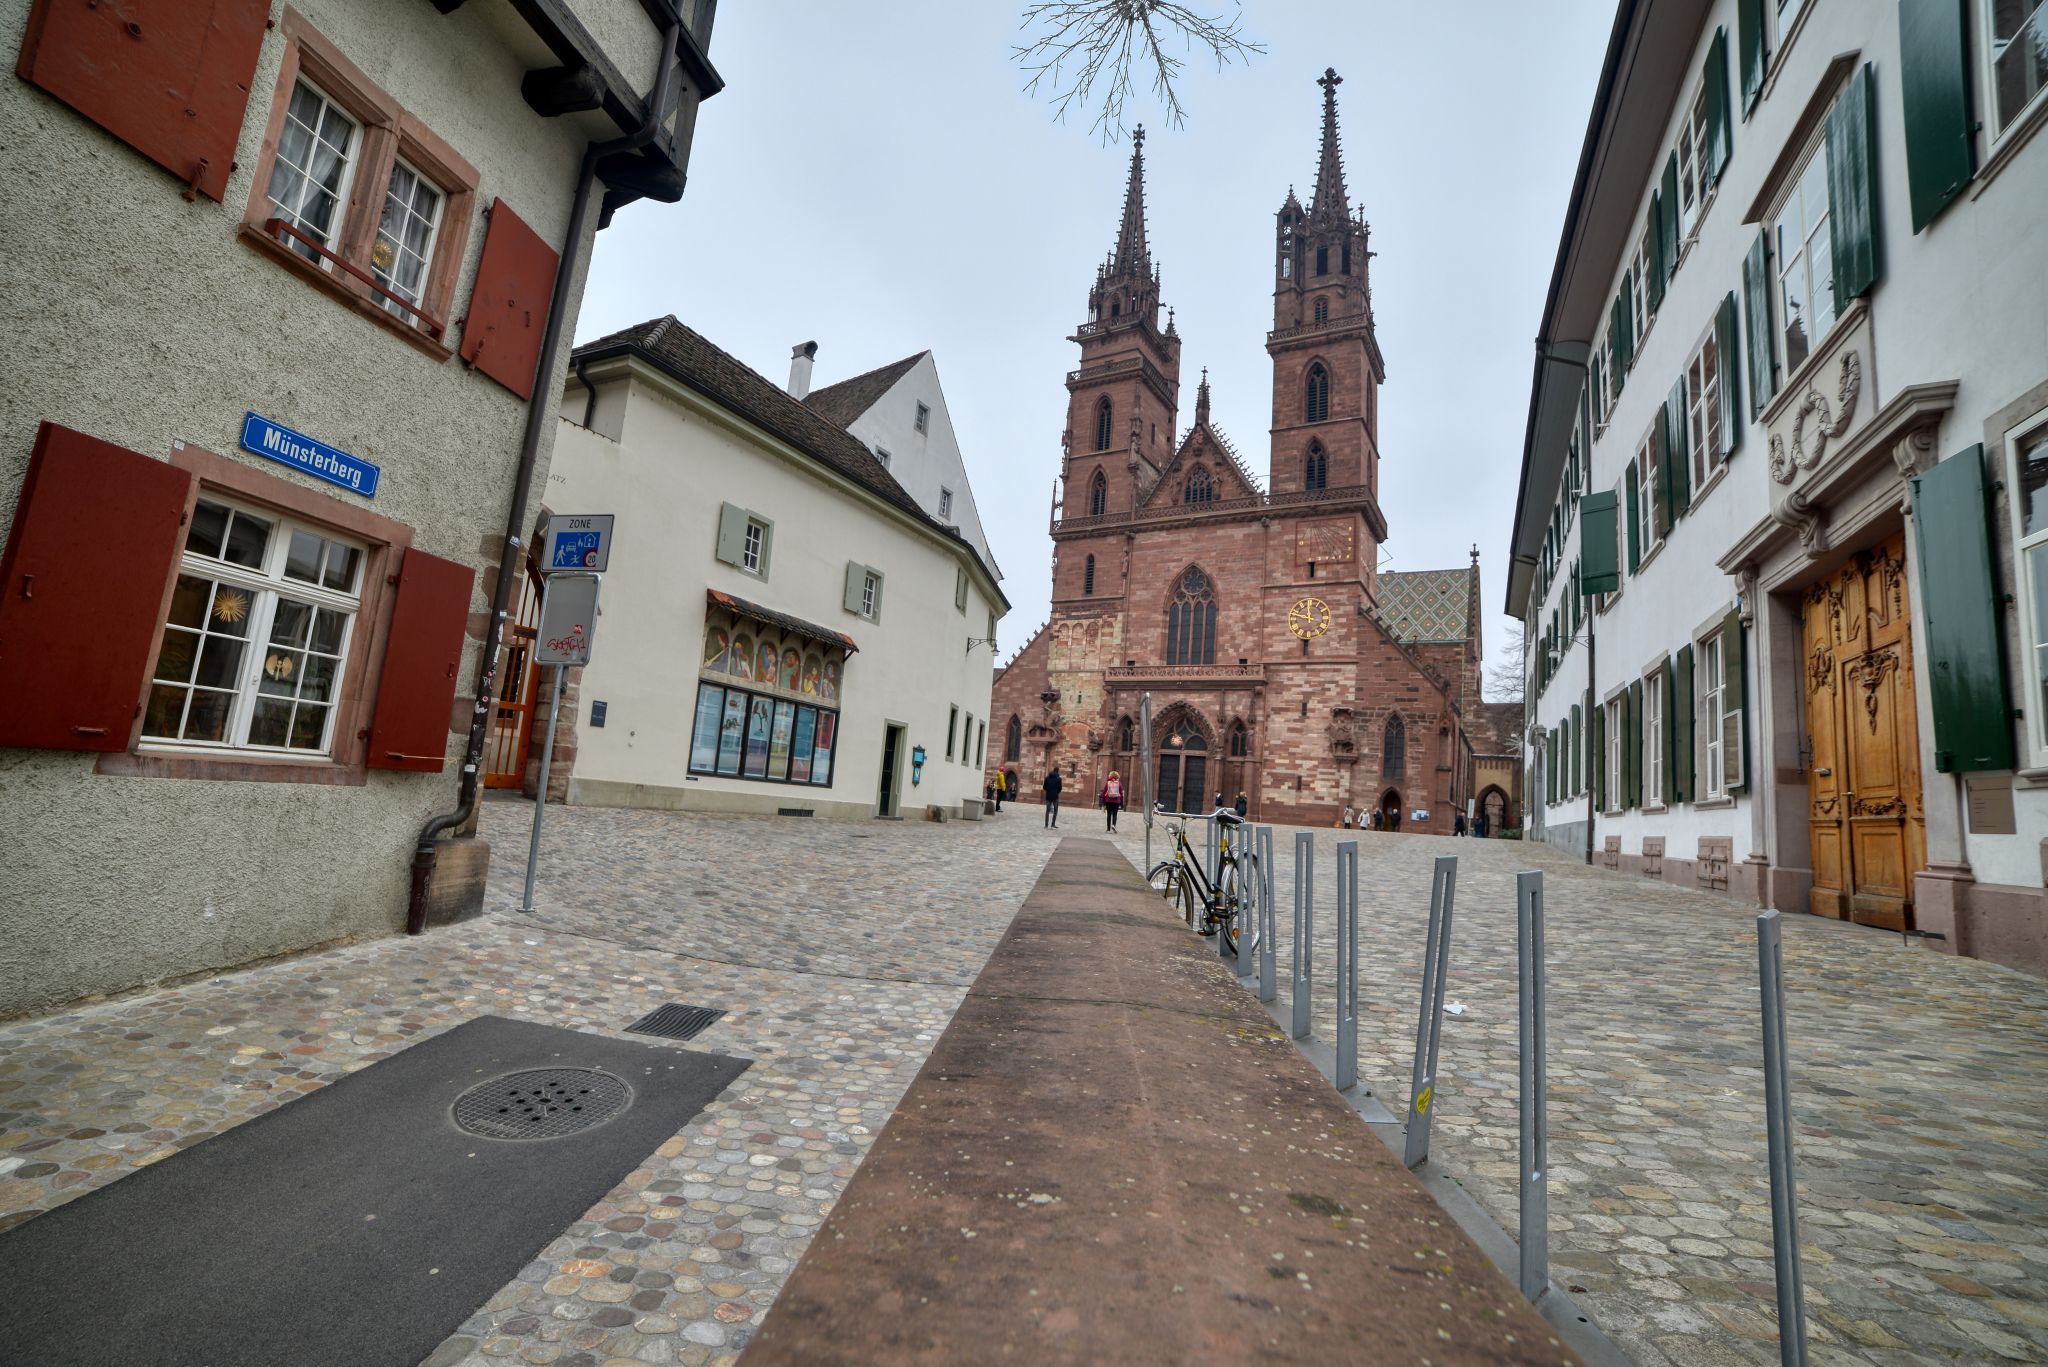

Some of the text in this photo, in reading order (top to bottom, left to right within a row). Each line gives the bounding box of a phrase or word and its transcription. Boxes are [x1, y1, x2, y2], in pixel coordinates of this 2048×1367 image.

[263, 427, 362, 488] Münsterberg
[549, 473, 566, 485] ATZ
[569, 519, 592, 529] ZONE
[587, 555, 596, 563] 20
